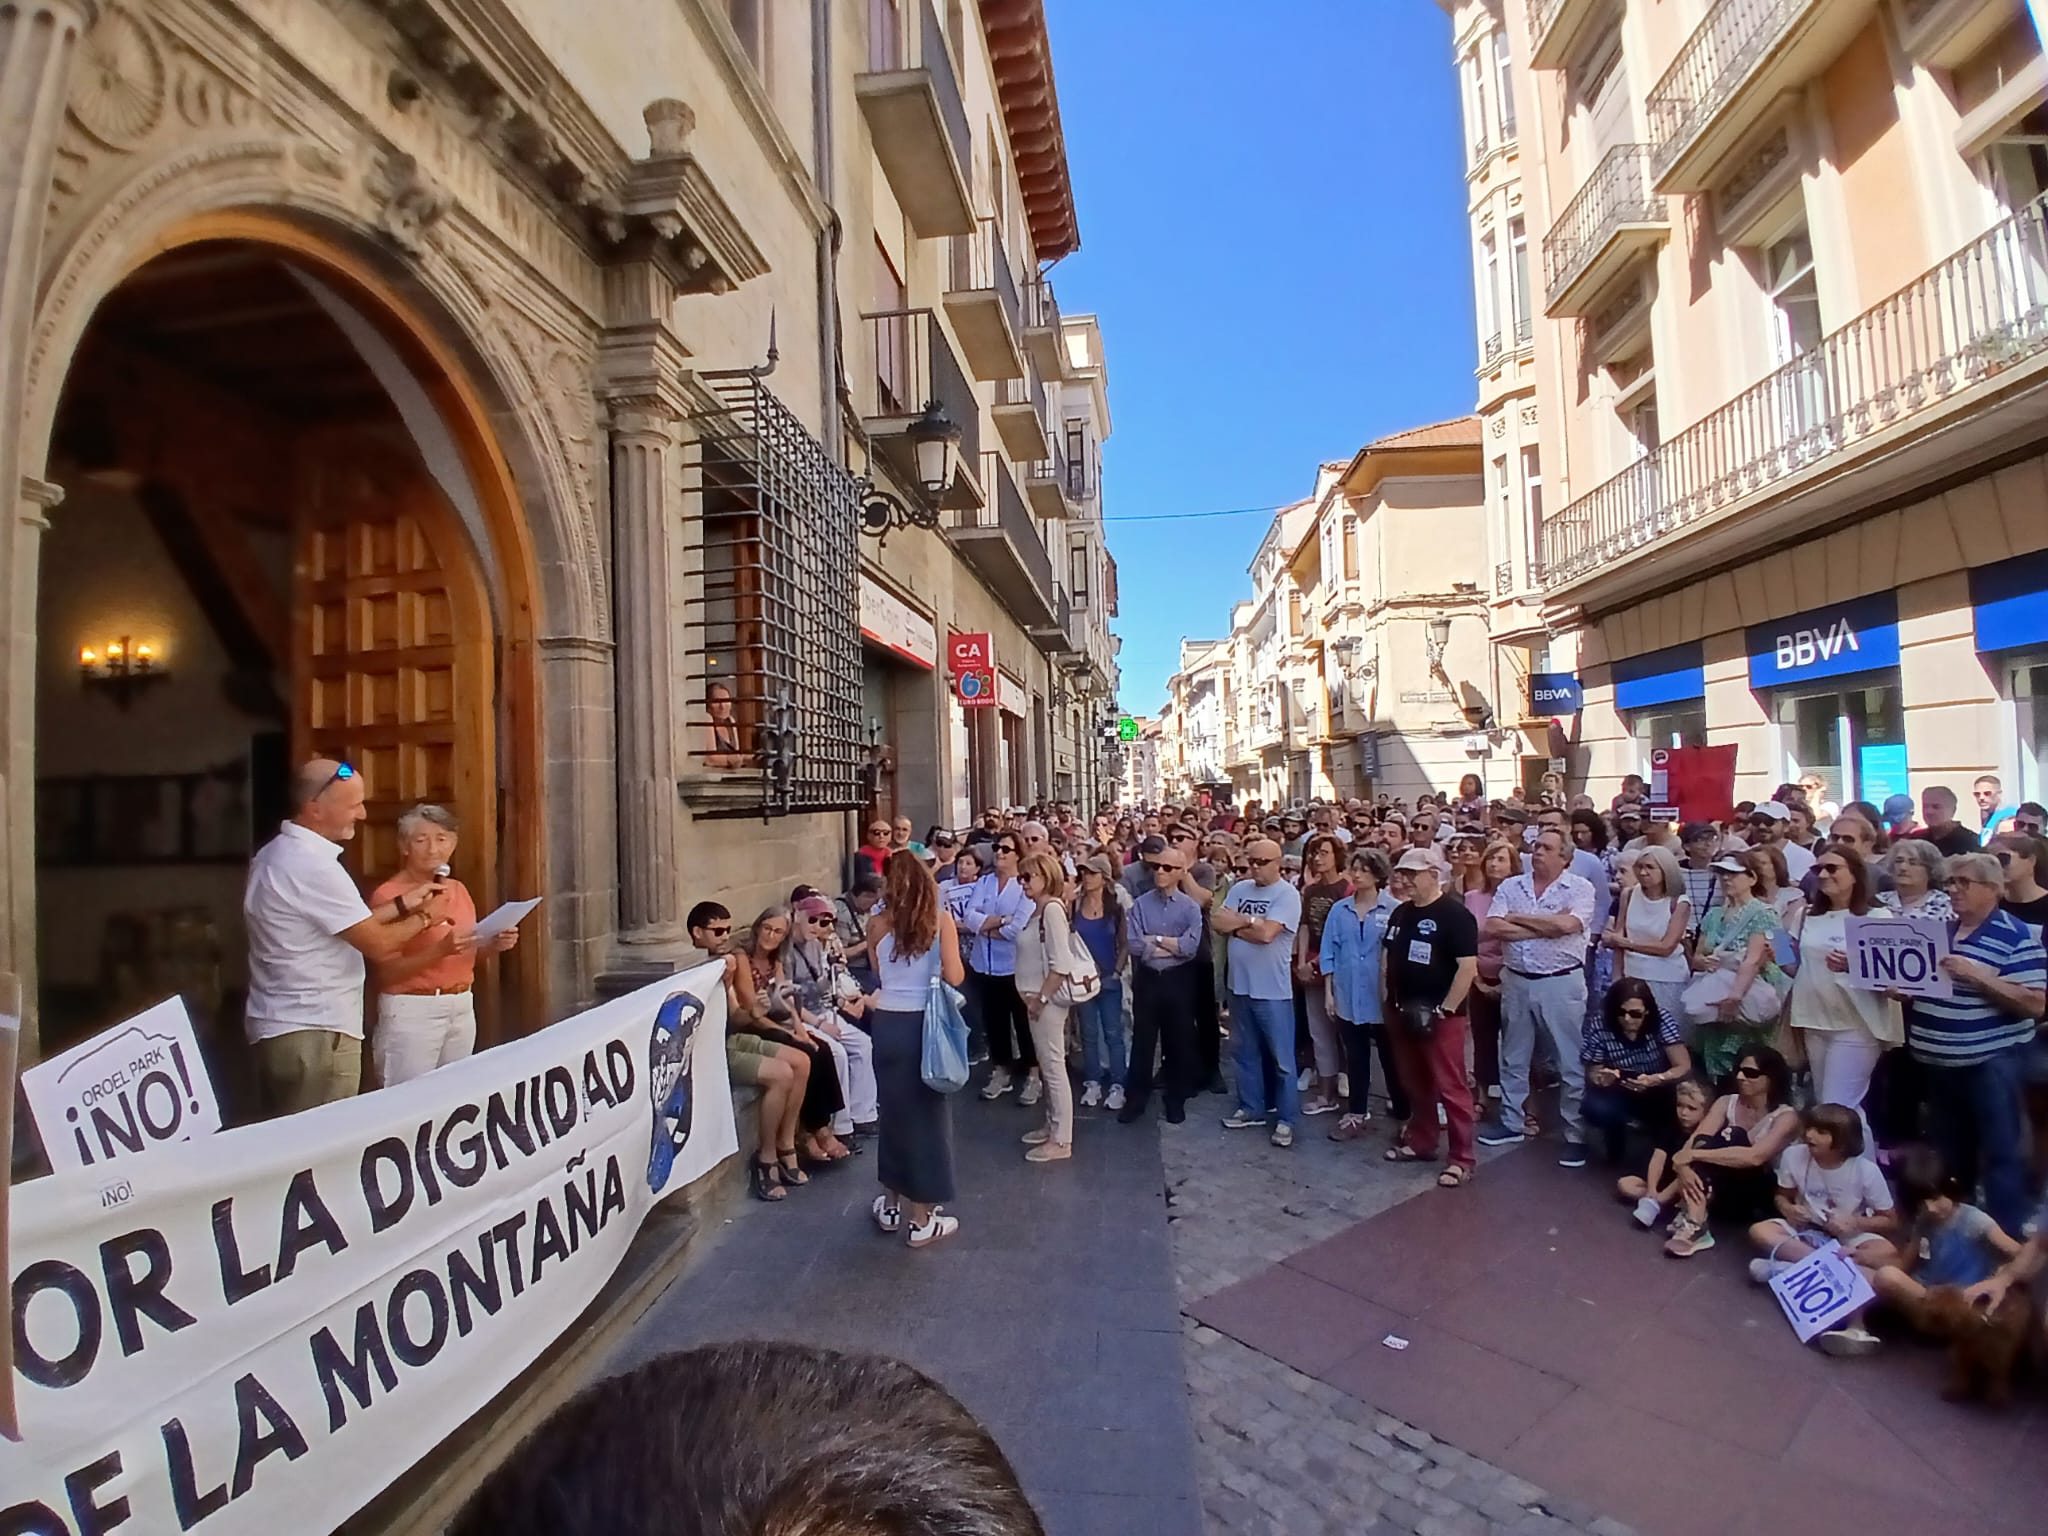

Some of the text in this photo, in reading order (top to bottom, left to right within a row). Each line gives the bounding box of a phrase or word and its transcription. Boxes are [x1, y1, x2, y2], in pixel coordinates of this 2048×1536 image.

[955, 643, 981, 657] CA
[1776, 617, 1860, 670] BBVA
[1534, 687, 1572, 700] BBVA
[1858, 940, 1939, 982] ¡NO!
[66, 1041, 199, 1166] ¡NO!
[82, 1046, 165, 1107] OROEL PARK
[211, 1168, 349, 1306] LA
[360, 1039, 636, 1234] DIGNIDAD
[1783, 1260, 1849, 1323] ¡NO!
[161, 1373, 309, 1532] LA
[310, 1148, 626, 1434] MONTAÑA
